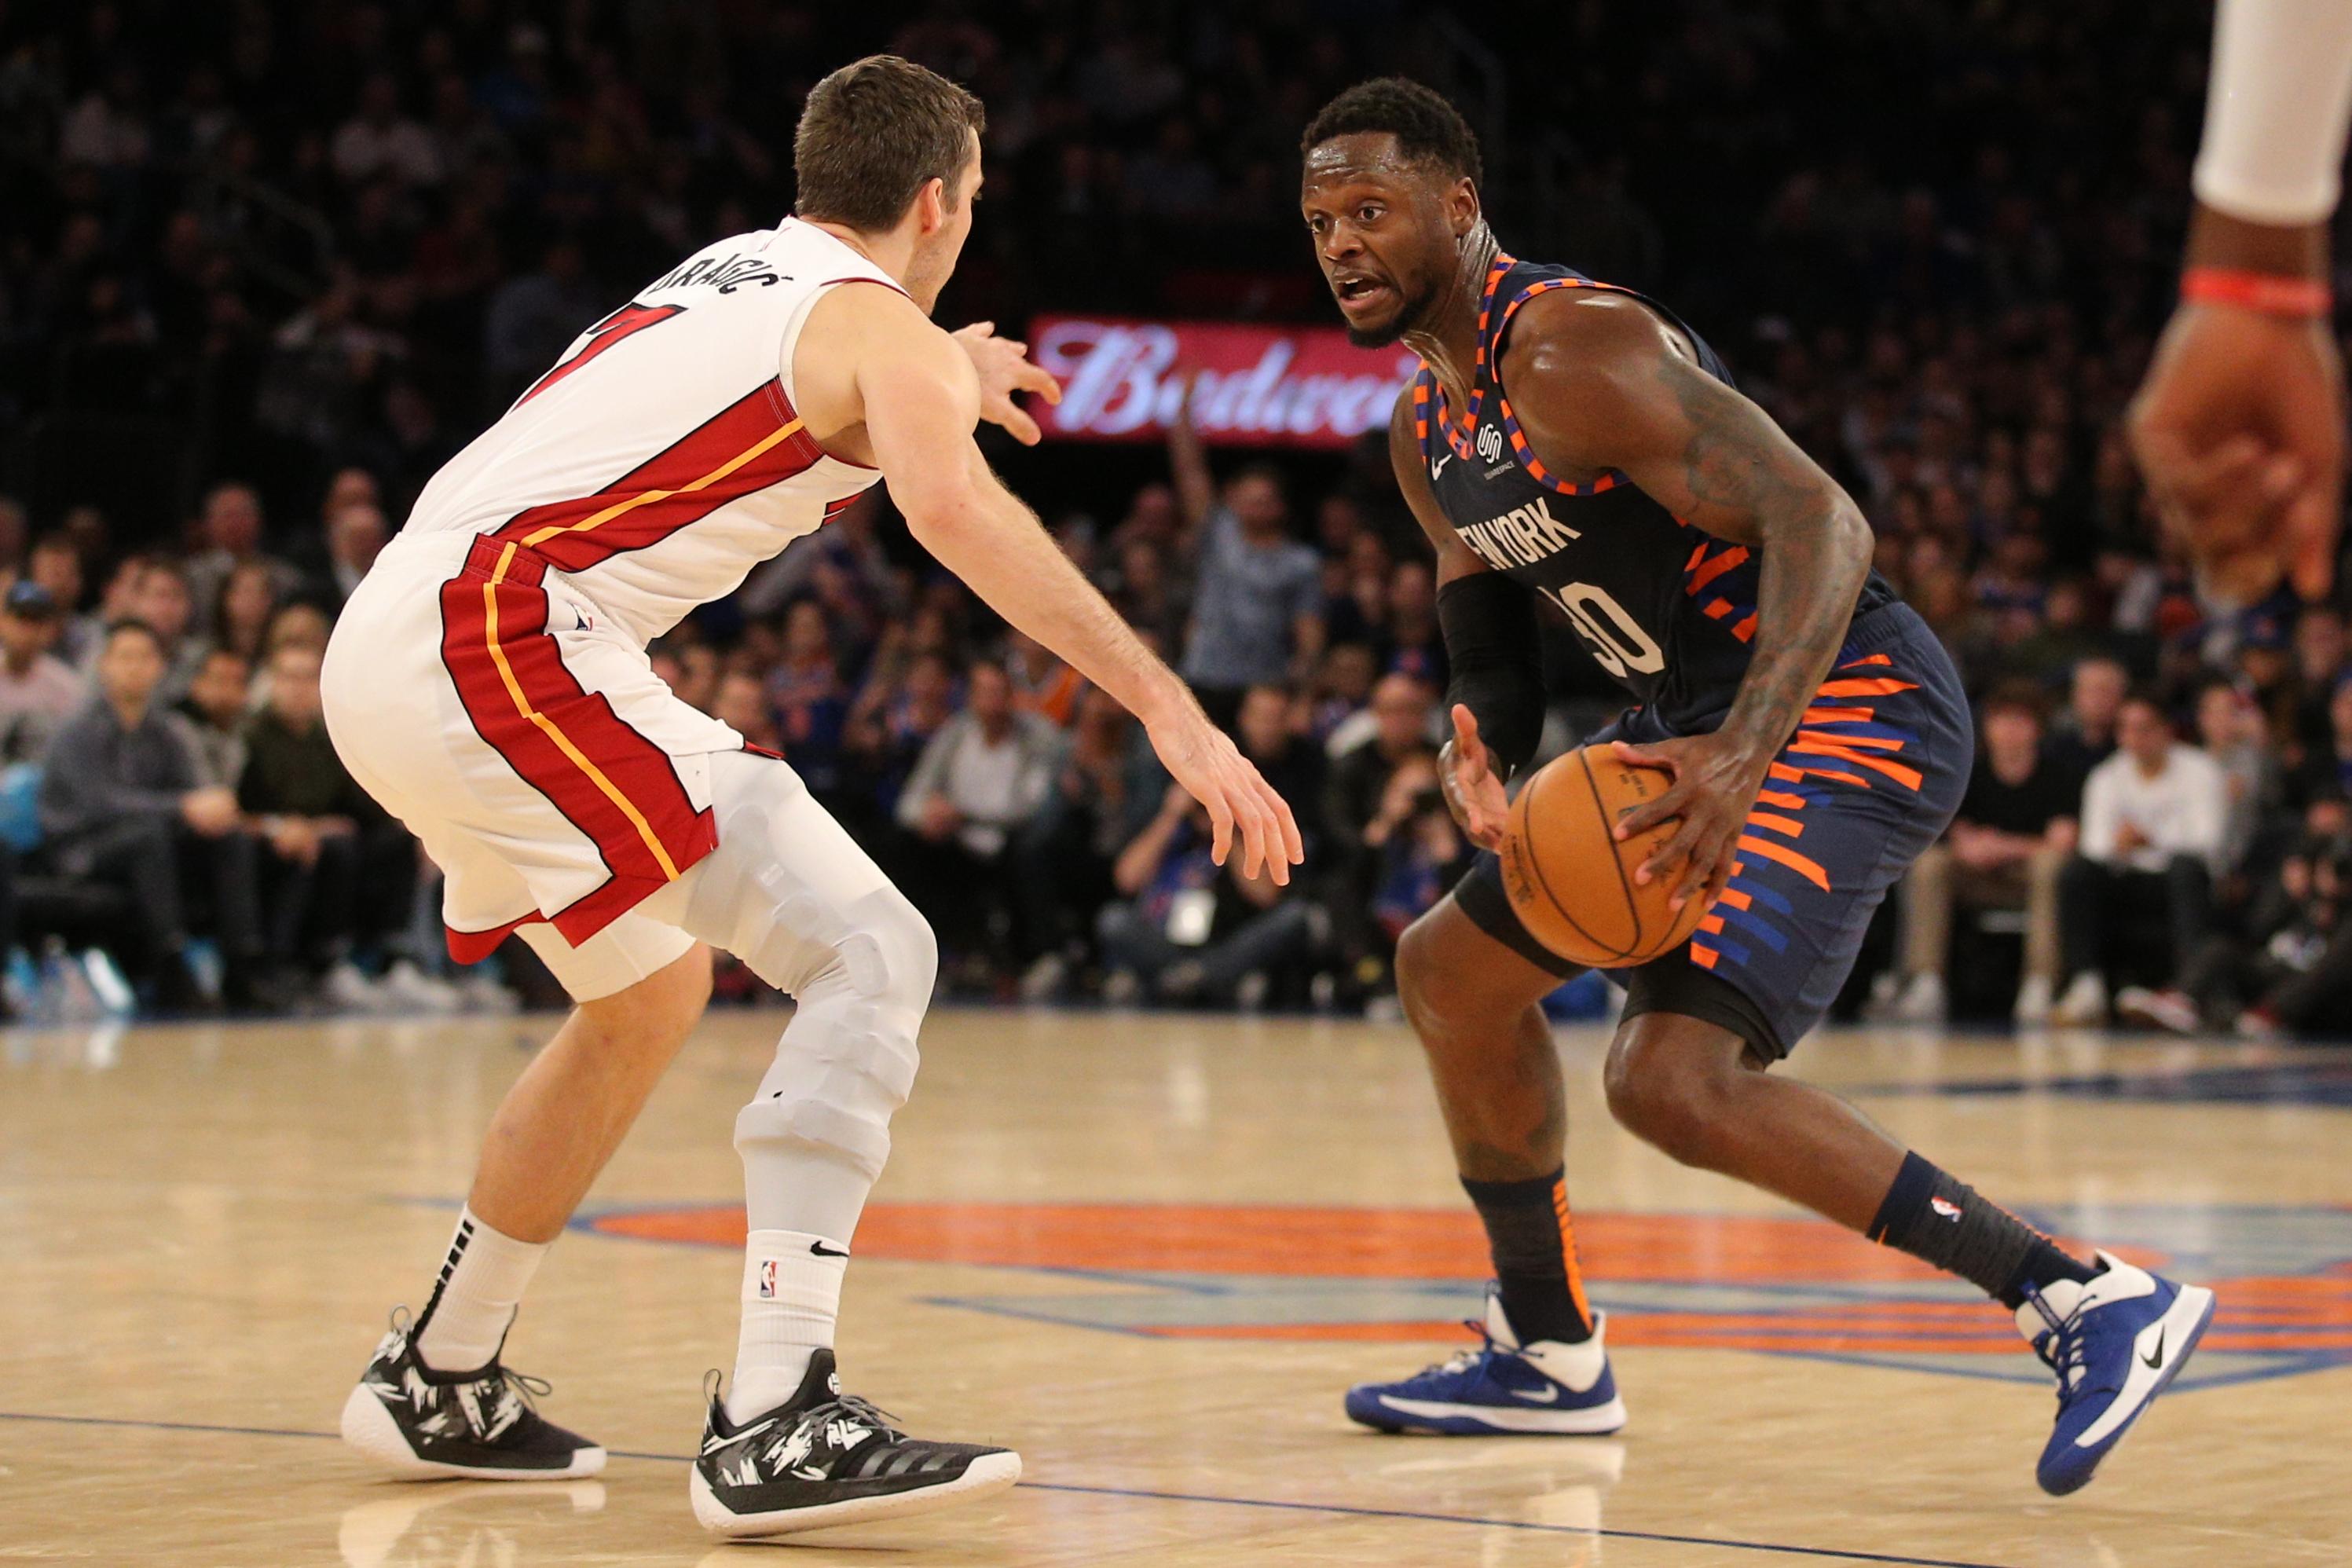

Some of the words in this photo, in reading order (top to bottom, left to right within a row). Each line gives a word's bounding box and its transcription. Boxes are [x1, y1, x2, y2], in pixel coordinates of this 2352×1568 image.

[510, 302, 687, 414] 7
[1036, 320, 1418, 437] Budwei
[1454, 522, 1515, 570] EW
[1485, 496, 1582, 566] YORK
